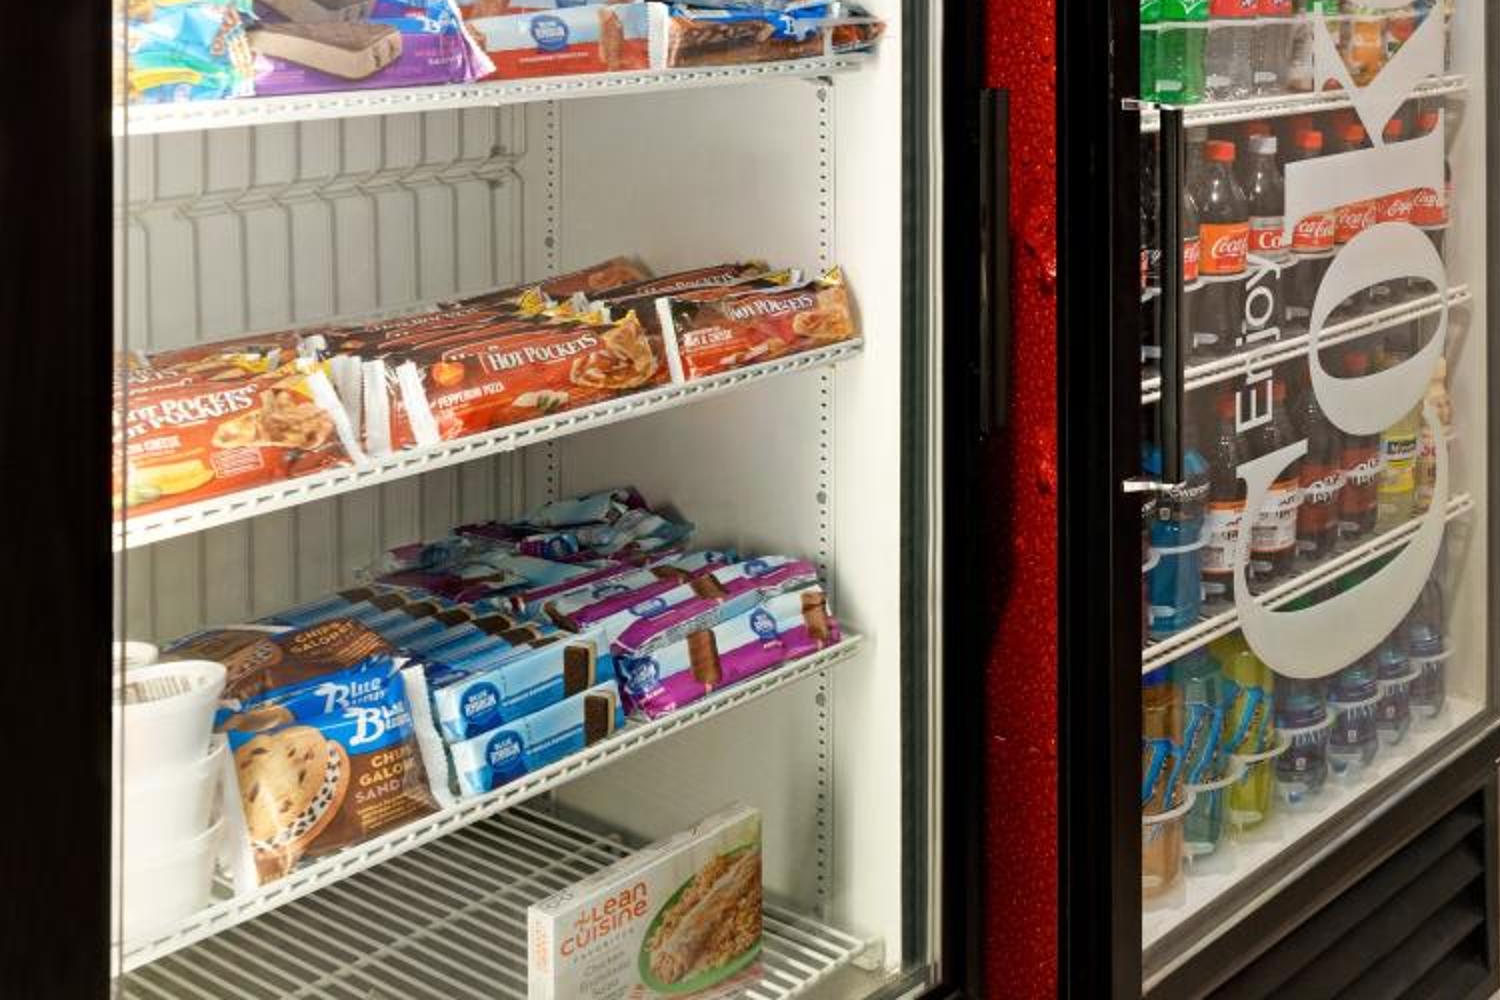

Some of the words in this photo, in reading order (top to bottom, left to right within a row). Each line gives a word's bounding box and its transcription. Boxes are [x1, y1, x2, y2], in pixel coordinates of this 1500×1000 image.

[489, 350, 523, 371] HOT
[525, 334, 598, 362] POCKETS
[1235, 251, 1281, 432] Enjoy
[592, 881, 648, 923] Lean
